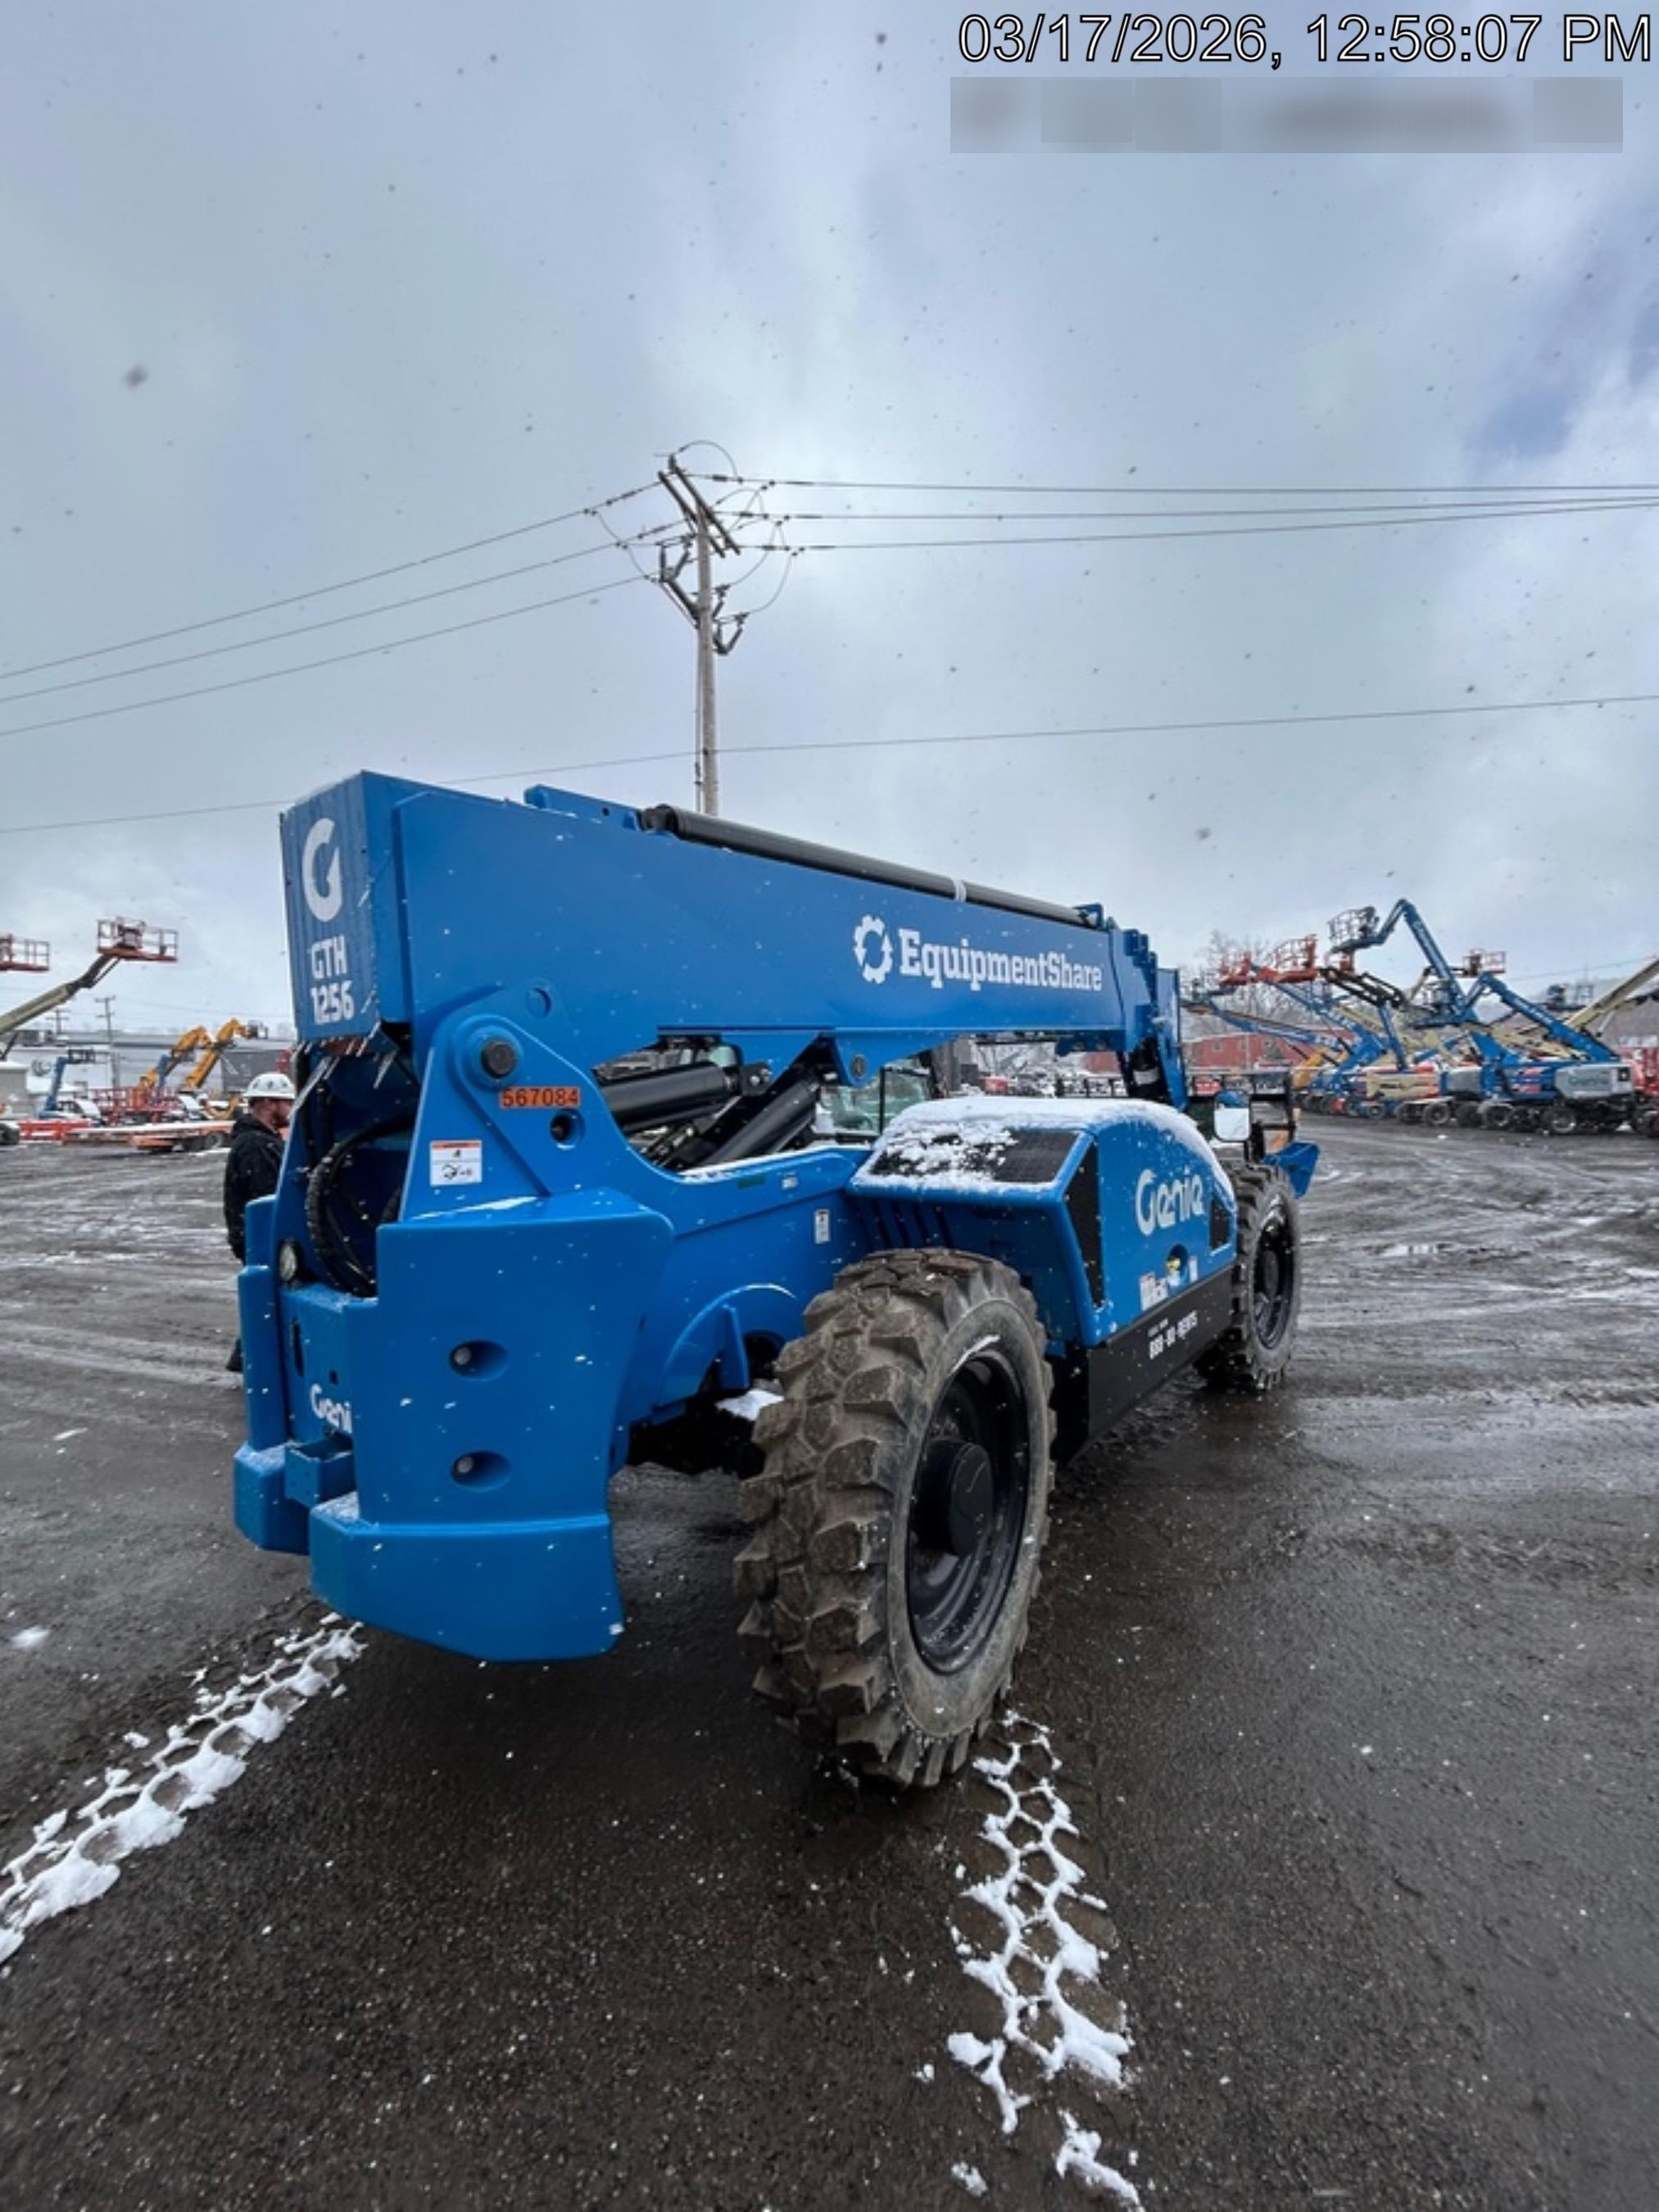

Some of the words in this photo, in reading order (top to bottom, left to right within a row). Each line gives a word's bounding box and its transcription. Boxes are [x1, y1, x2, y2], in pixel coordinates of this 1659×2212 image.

[310, 935, 347, 979] GTH
[898, 928, 1102, 991] EquipmentShare
[310, 981, 355, 1025] 1256
[501, 1088, 578, 1107] 567084
[1135, 1168, 1205, 1235] Genie
[310, 1383, 352, 1434] Geni
